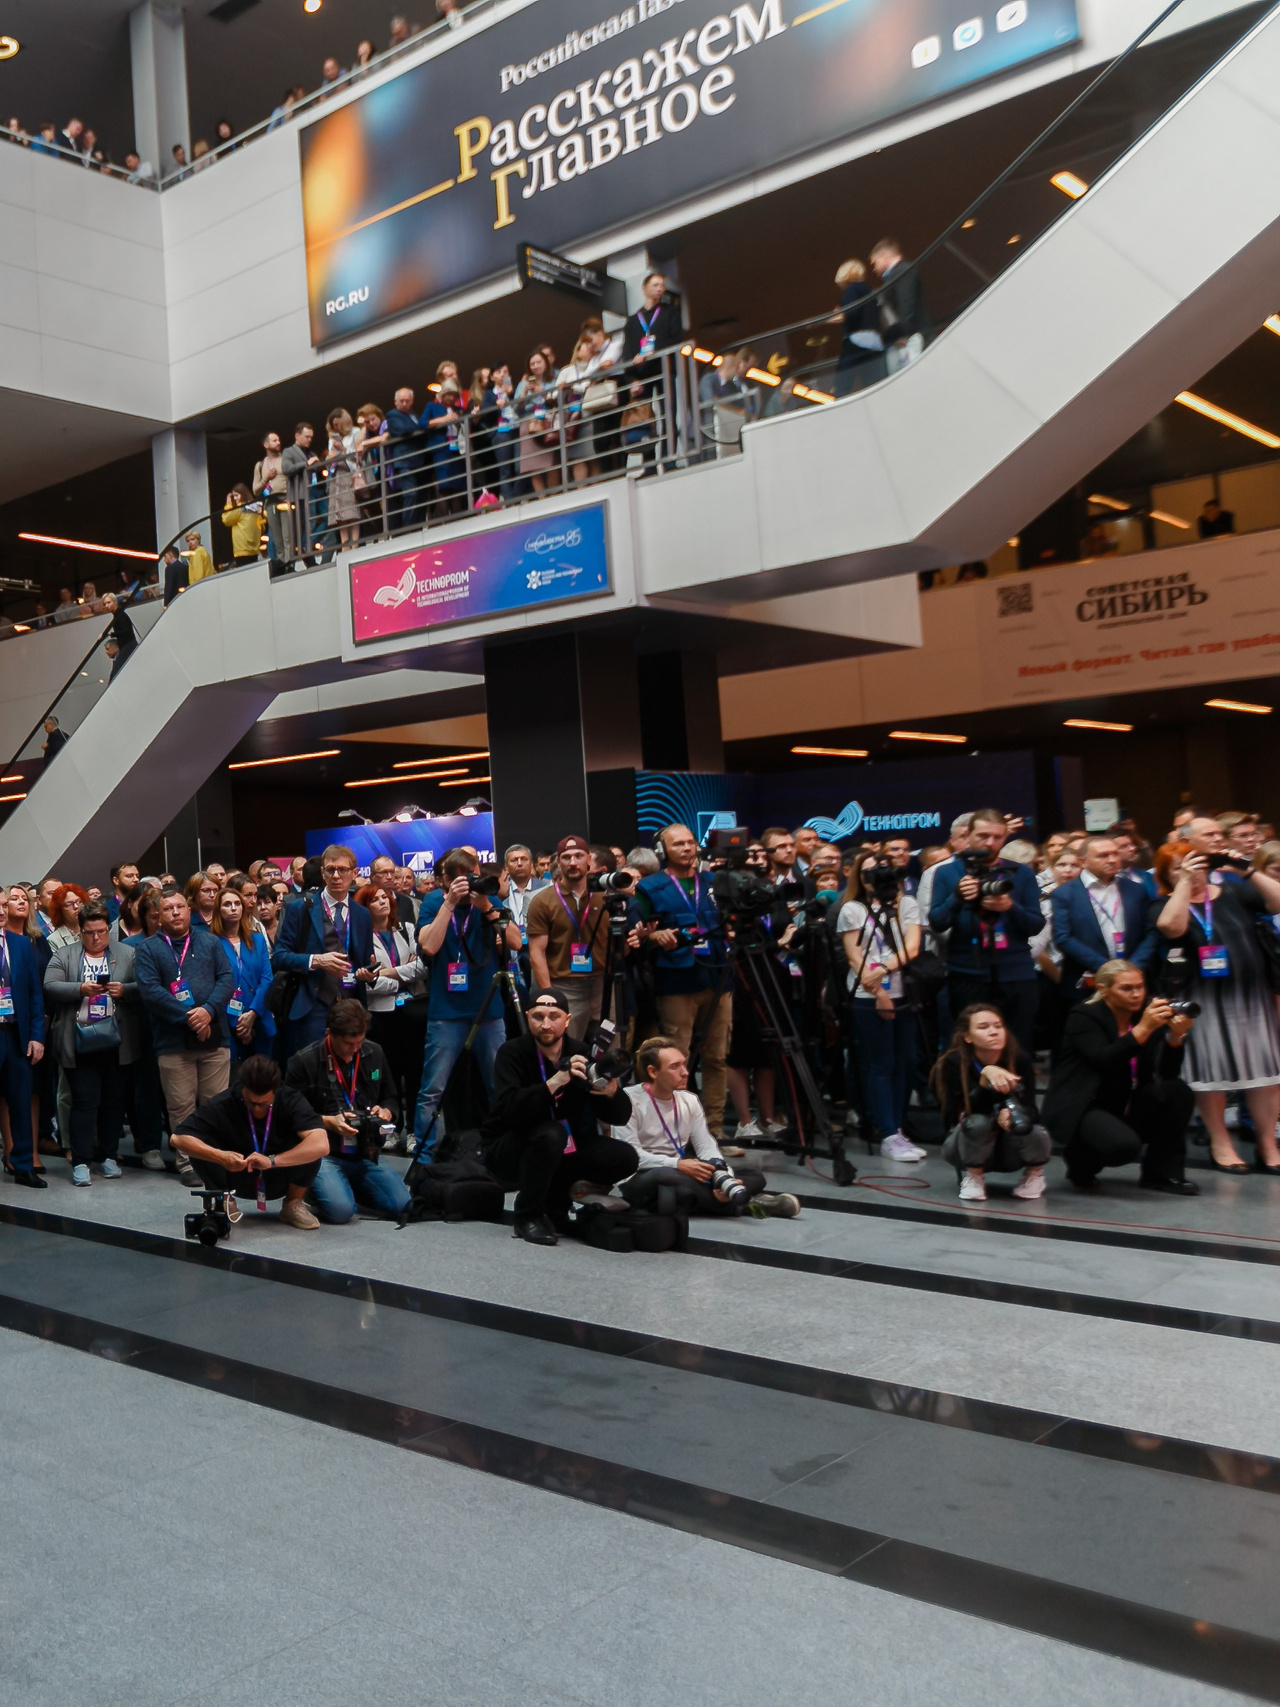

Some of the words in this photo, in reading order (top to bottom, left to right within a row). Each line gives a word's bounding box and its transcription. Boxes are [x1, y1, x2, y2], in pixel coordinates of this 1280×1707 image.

[499, 6, 637, 93] Российская
[453, 0, 789, 185] Расскажем
[490, 64, 737, 230] Главное
[325, 285, 370, 317] RG.RU
[416, 570, 469, 594] TECHNOPROM
[1085, 572, 1189, 598] СОВЕТСКАЯ
[1076, 583, 1209, 623] СИБИРЬ
[862, 811, 941, 831] ТЕХНОПРОМ
